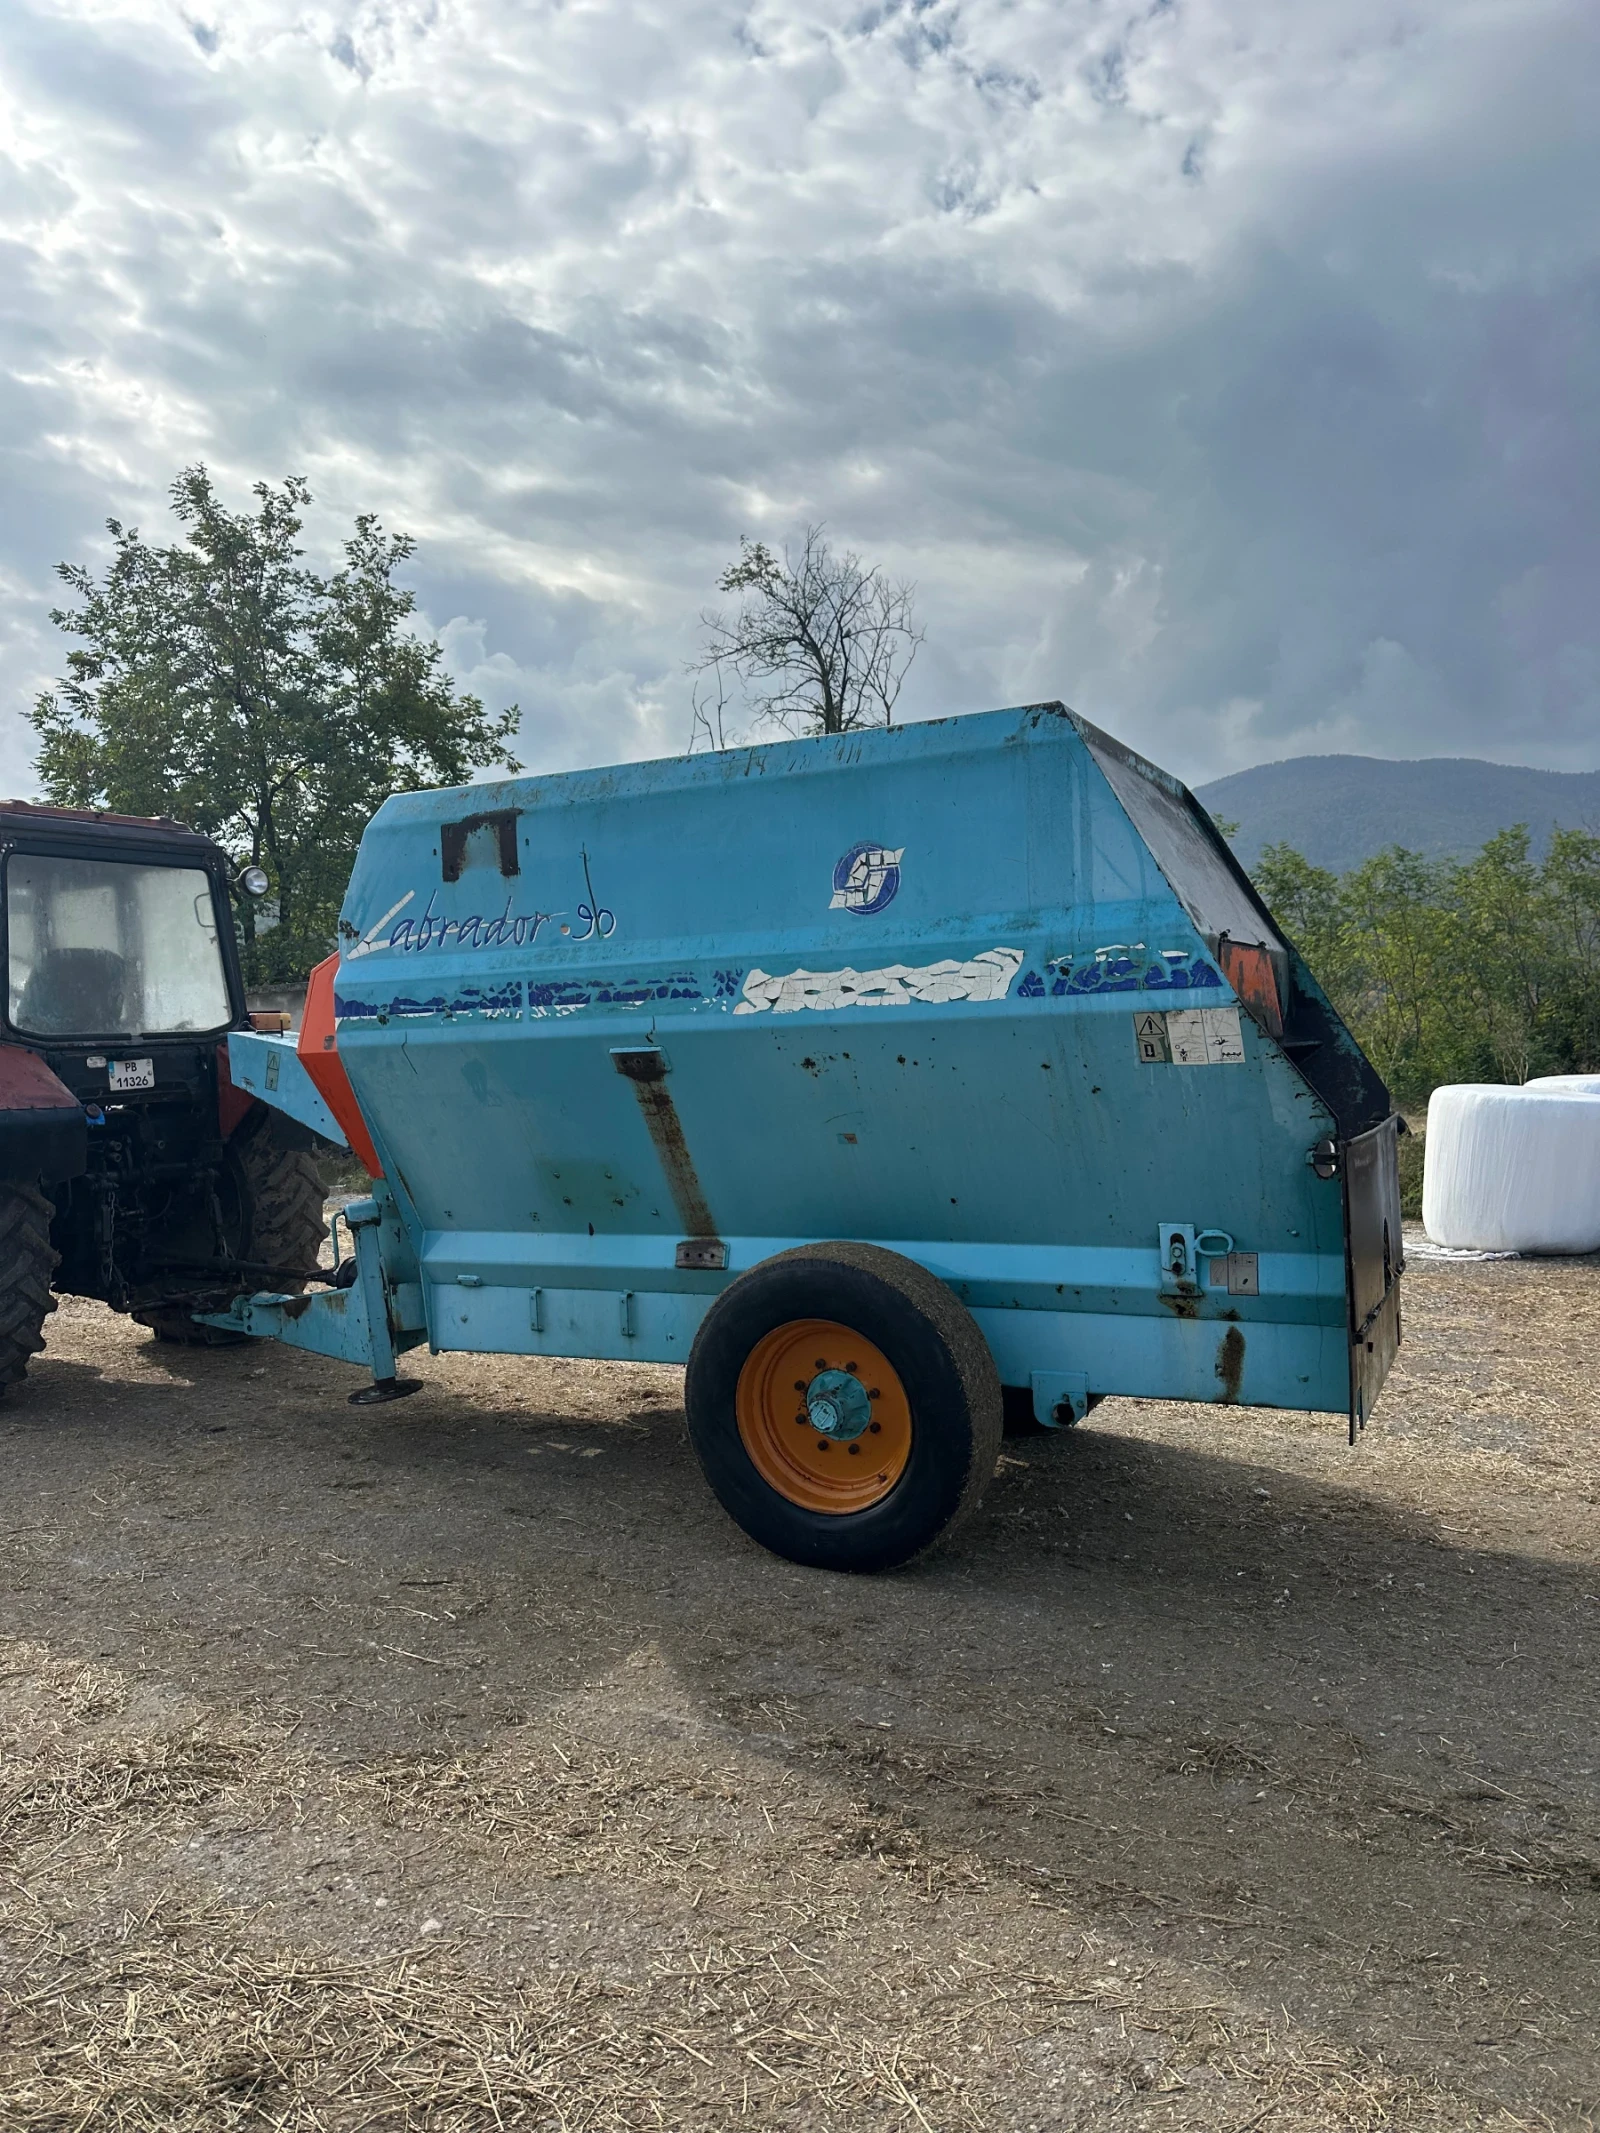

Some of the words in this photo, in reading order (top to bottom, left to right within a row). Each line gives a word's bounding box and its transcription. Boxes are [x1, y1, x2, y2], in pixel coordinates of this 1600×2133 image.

[346, 889, 565, 959] Labrador
[125, 1062, 138, 1073] PB
[117, 1076, 149, 1088] 11326
